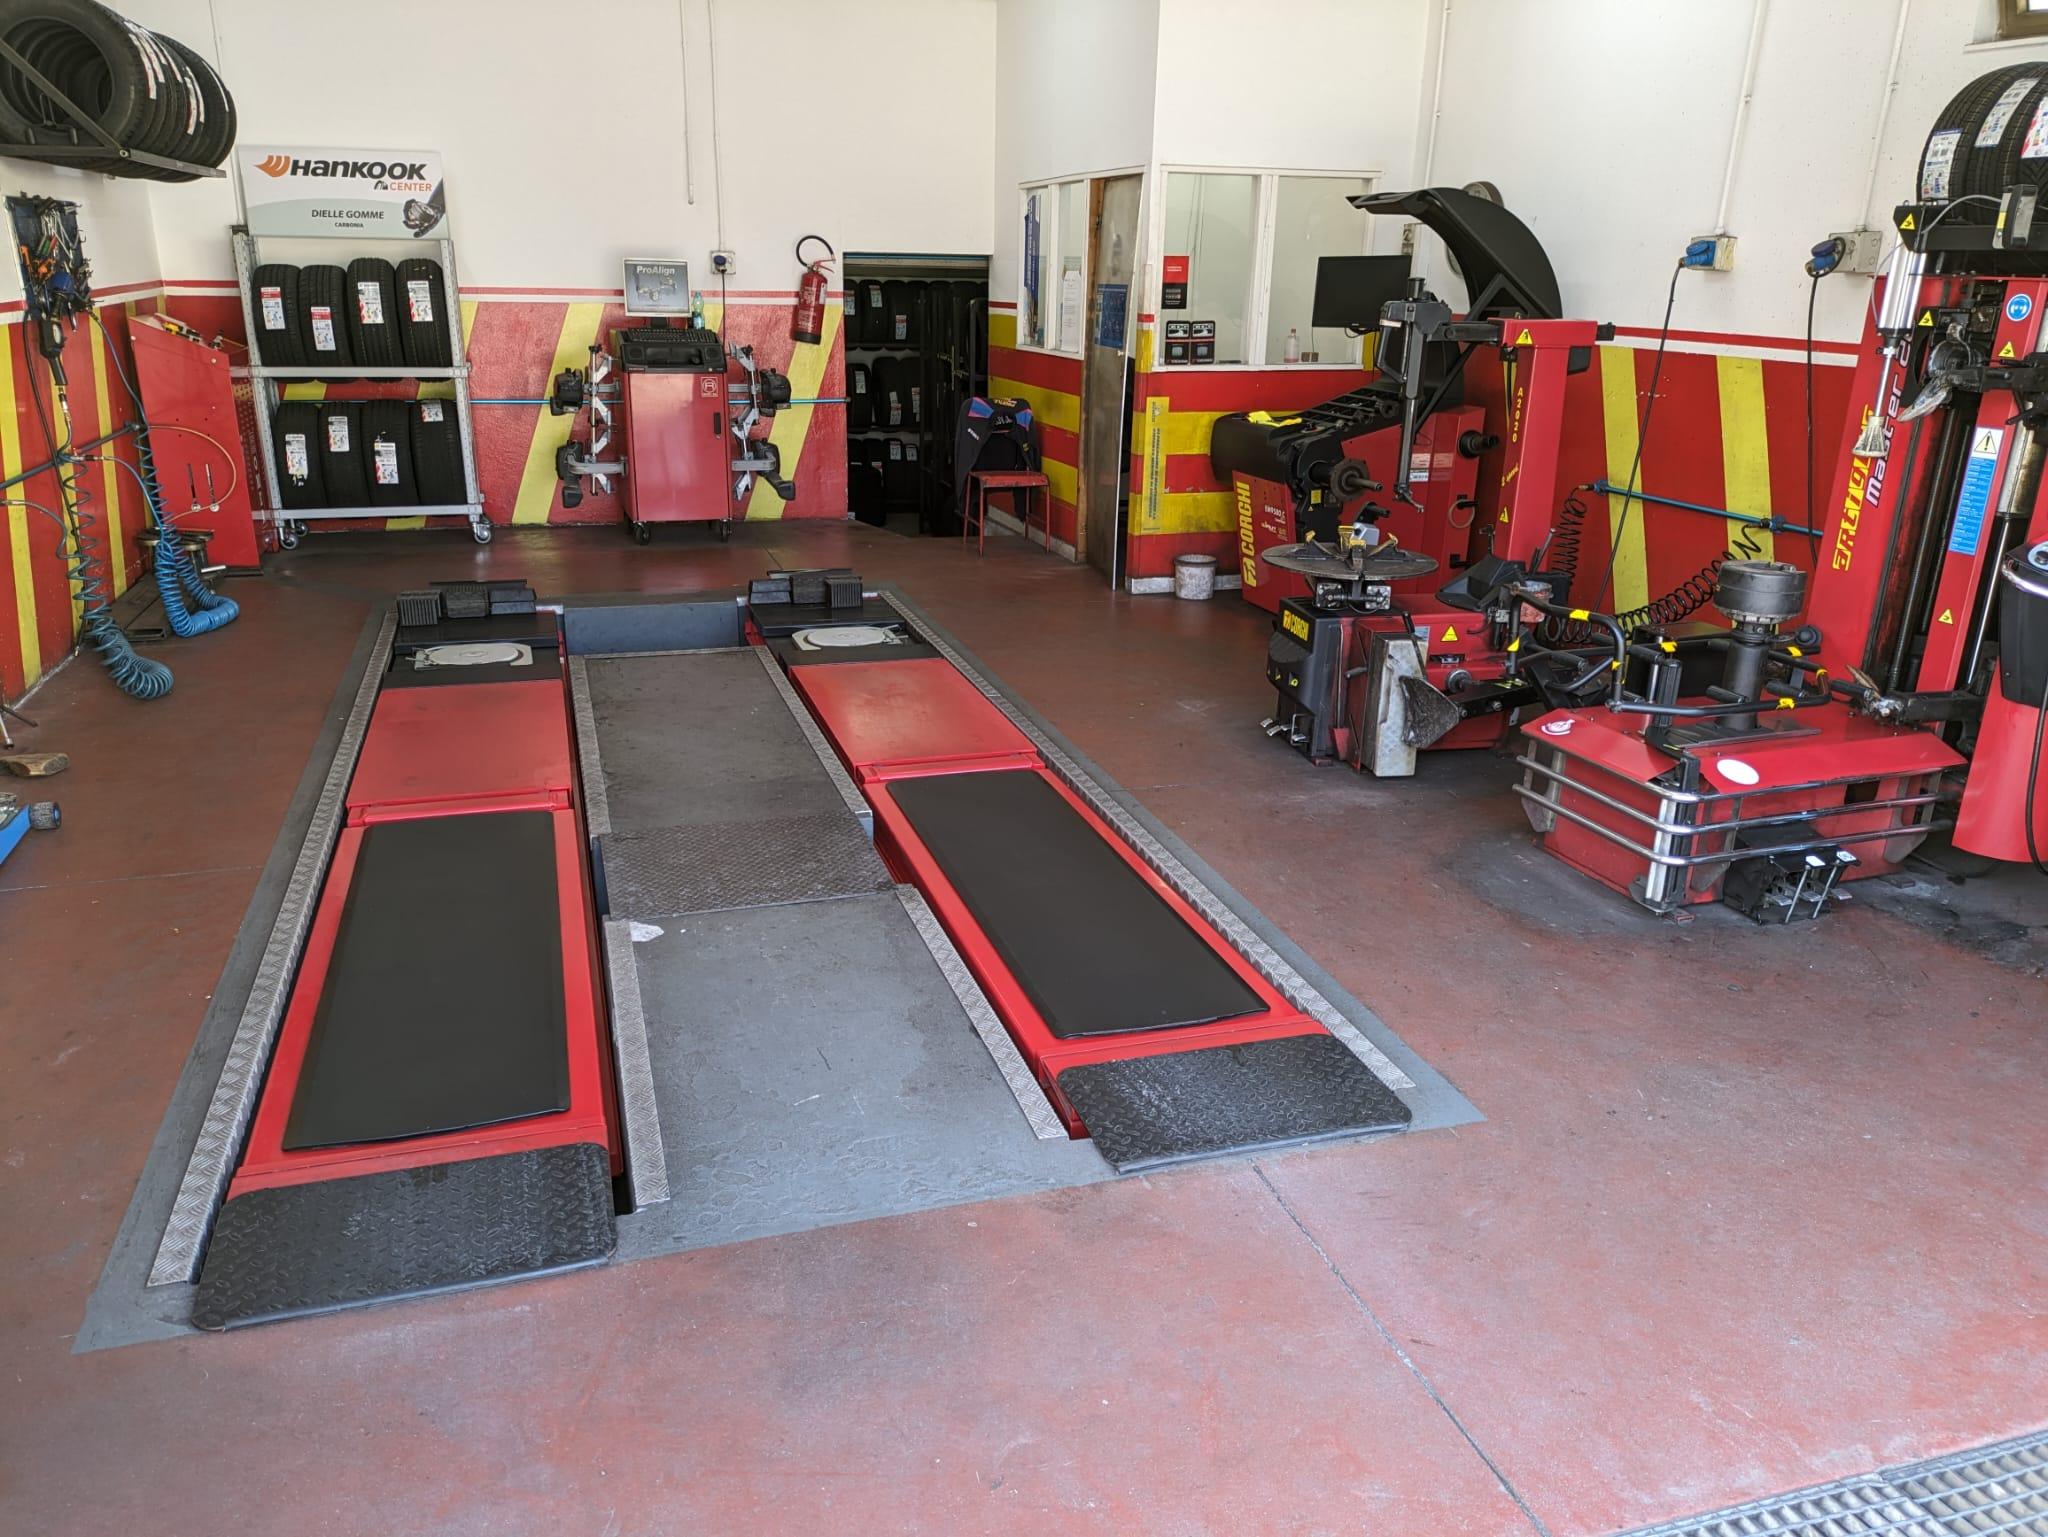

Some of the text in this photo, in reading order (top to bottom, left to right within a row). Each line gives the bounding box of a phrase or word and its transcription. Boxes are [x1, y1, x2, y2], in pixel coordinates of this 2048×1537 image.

[389, 181, 432, 192] CENTER
[311, 209, 385, 219] DIELLE GOMME
[636, 265, 676, 276] ProAlign
[1236, 481, 1255, 557] CORGHI
[1290, 613, 1309, 642] CORGHI
